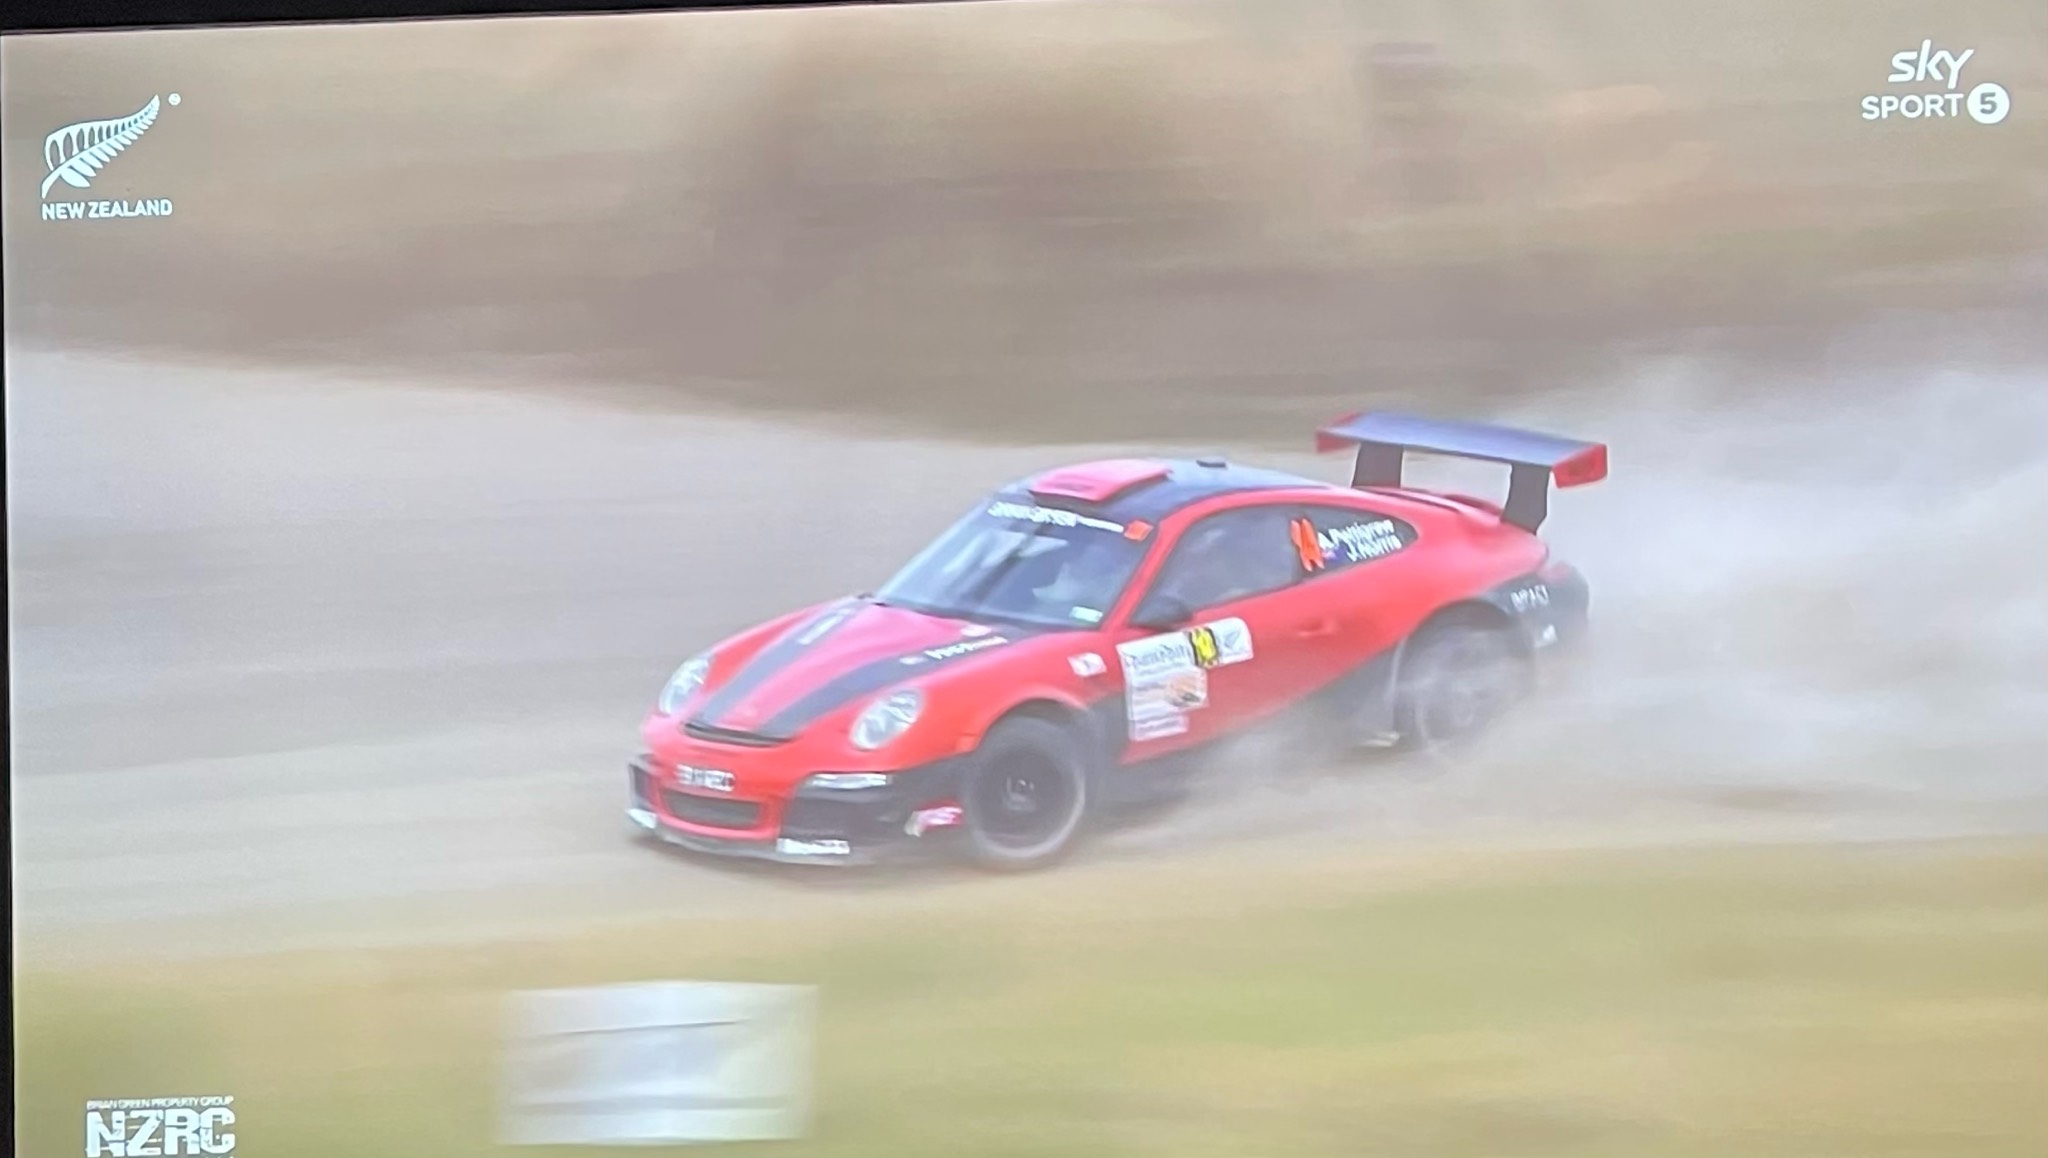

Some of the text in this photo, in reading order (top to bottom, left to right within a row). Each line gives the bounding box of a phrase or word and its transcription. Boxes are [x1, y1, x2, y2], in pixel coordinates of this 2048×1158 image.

[1888, 39, 1975, 89] sky
[1861, 93, 1965, 120] SPORT
[42, 199, 173, 220] NEW ZEALAND
[200, 1095, 234, 1107] GROUP
[86, 1107, 236, 1158] NZRC
